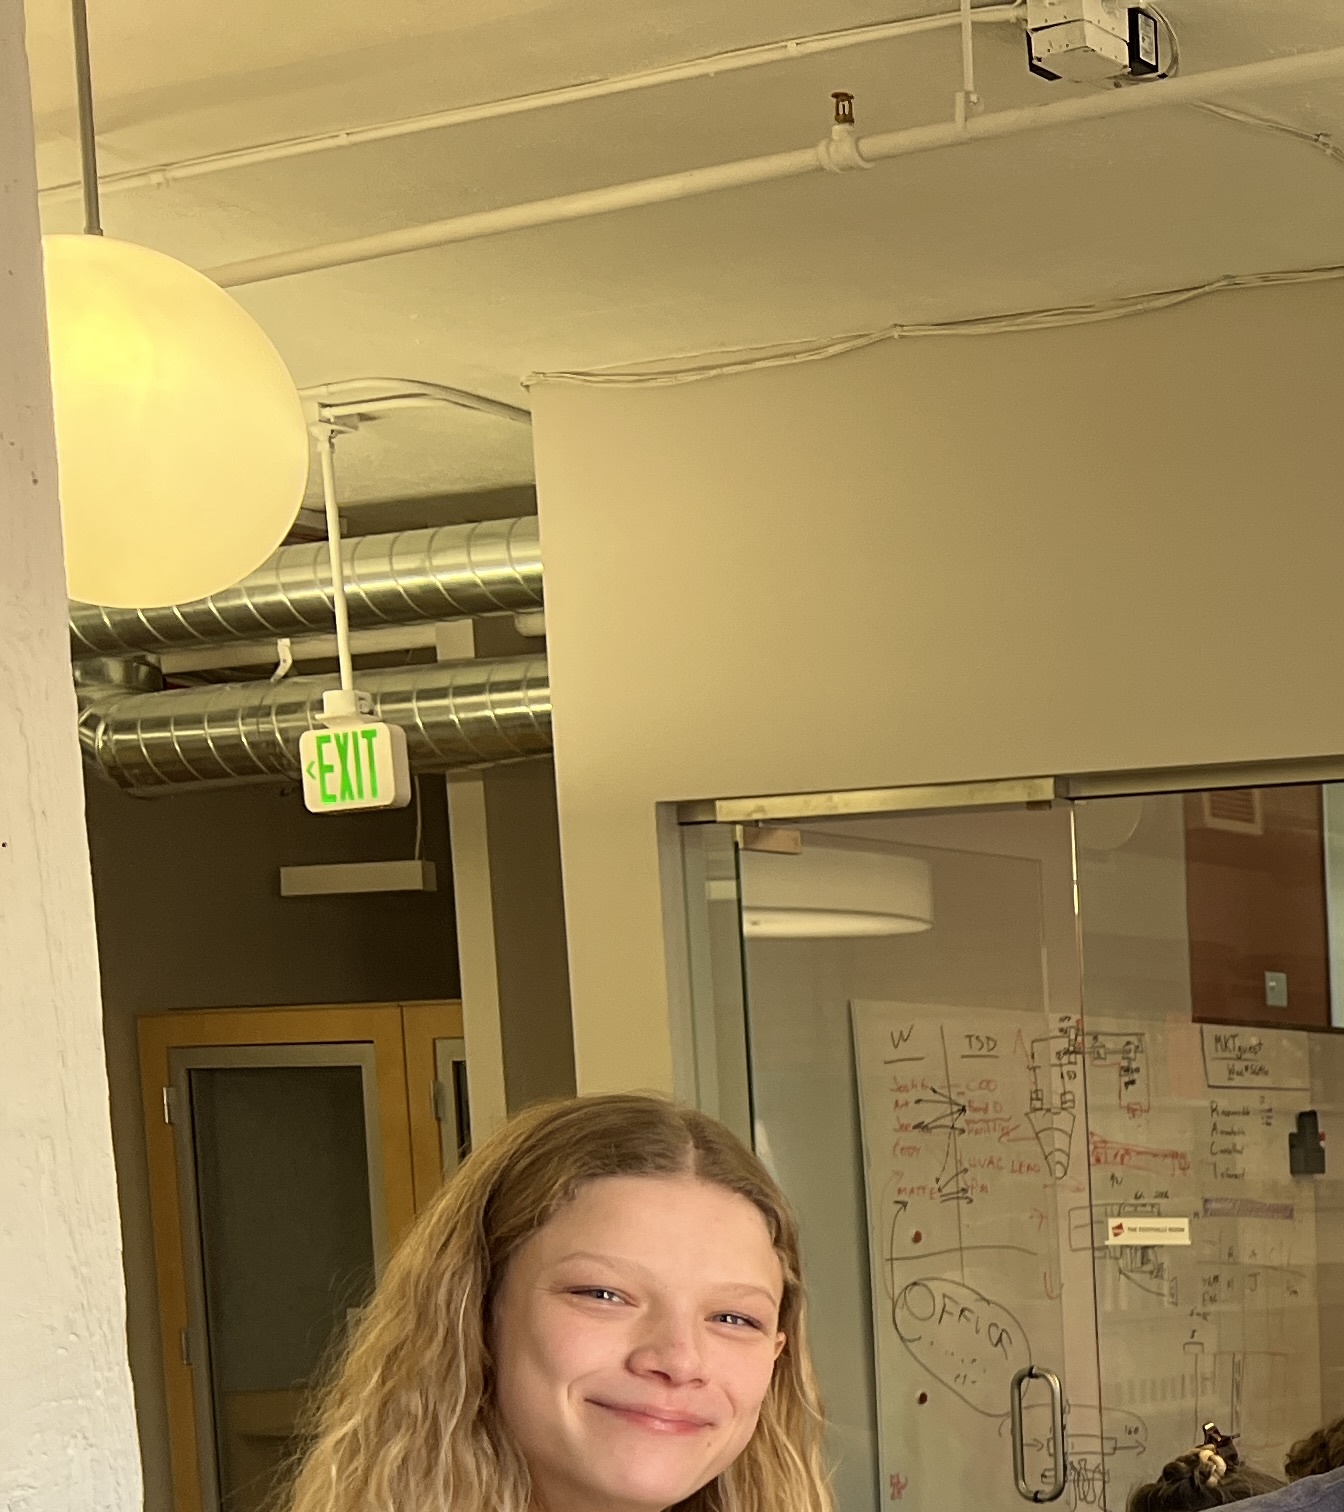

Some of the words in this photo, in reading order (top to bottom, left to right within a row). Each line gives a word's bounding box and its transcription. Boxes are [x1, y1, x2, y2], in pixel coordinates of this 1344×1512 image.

[316, 729, 378, 803] EXIT
[890, 1024, 915, 1050] W
[964, 1033, 998, 1053] TSD
